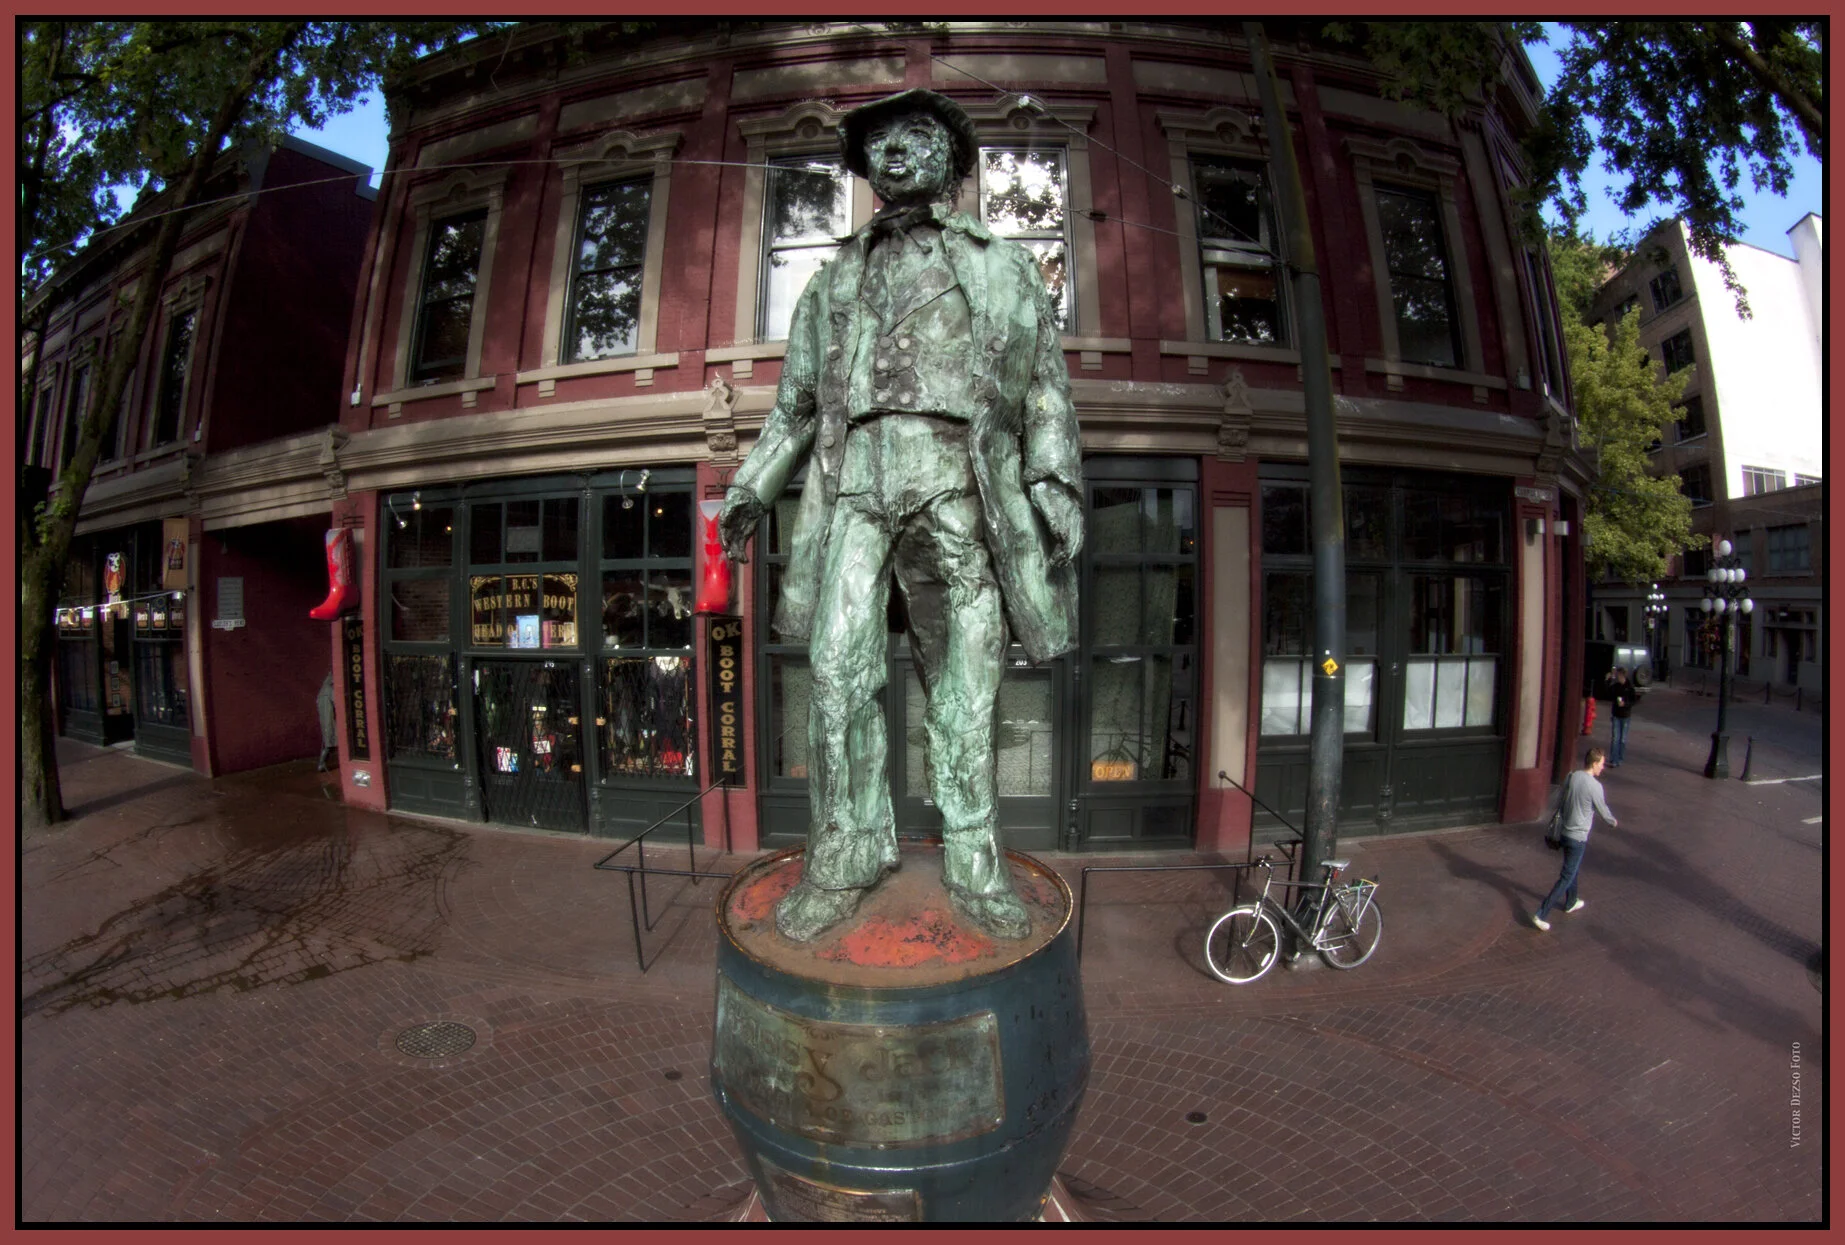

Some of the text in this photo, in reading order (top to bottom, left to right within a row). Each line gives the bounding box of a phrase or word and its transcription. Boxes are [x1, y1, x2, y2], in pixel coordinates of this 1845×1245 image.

[474, 594, 574, 612] WESTERN BOOT
[347, 626, 367, 748] OK BOOT CORRAL
[712, 621, 741, 772] OK BOOT CORRAL
[1095, 766, 1132, 778] OPEN
